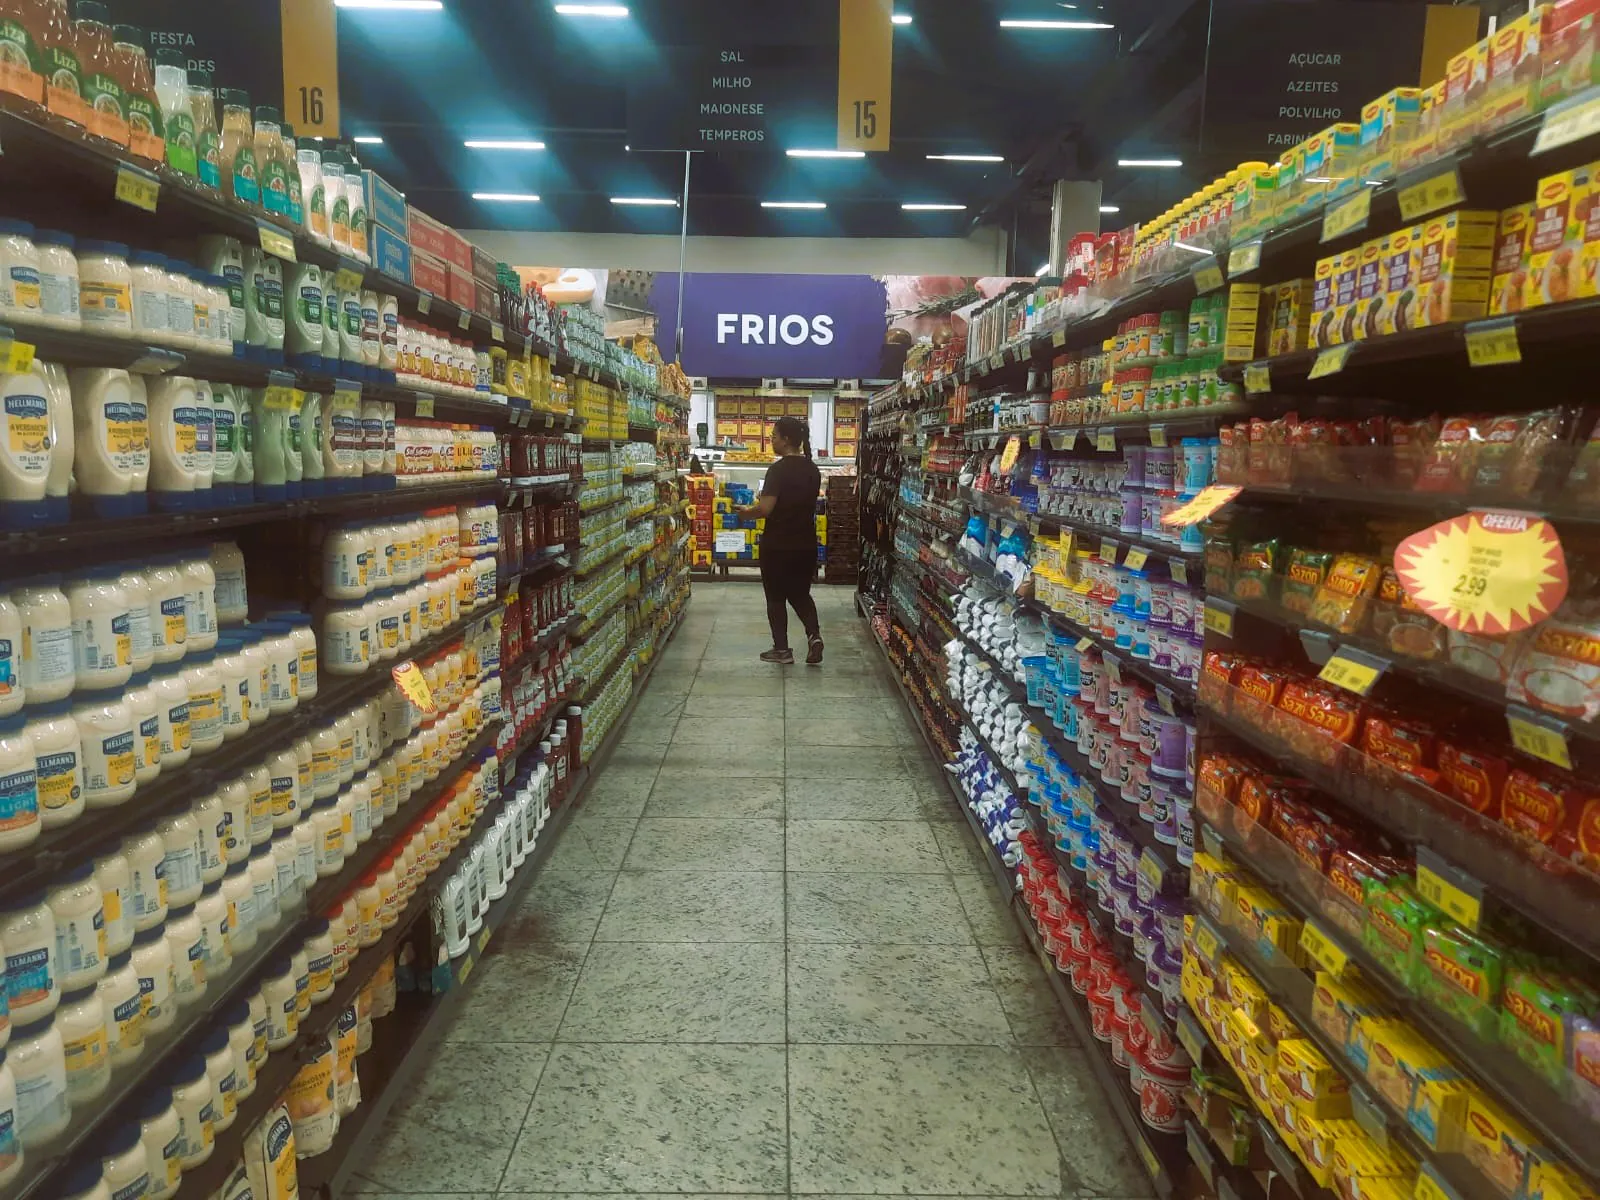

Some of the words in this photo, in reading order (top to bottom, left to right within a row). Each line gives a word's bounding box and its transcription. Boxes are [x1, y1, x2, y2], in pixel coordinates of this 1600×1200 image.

[150, 31, 196, 47] FESTA
[54, 48, 77, 72] Liza
[720, 51, 744, 63] SAL
[1288, 53, 1342, 67] AÇUCAR
[96, 74, 119, 96] Liza
[712, 76, 752, 89] MILHO
[1286, 81, 1339, 93] AZEITES
[299, 86, 325, 125] 16
[700, 103, 764, 116] MAIONESE
[853, 100, 877, 140] 15
[1279, 107, 1342, 119] POLVILHO
[699, 130, 765, 142] TEMPEROS
[1267, 133, 1312, 145] FARIN
[717, 313, 835, 346] FRIOS
[1482, 513, 1528, 531] OFERTA
